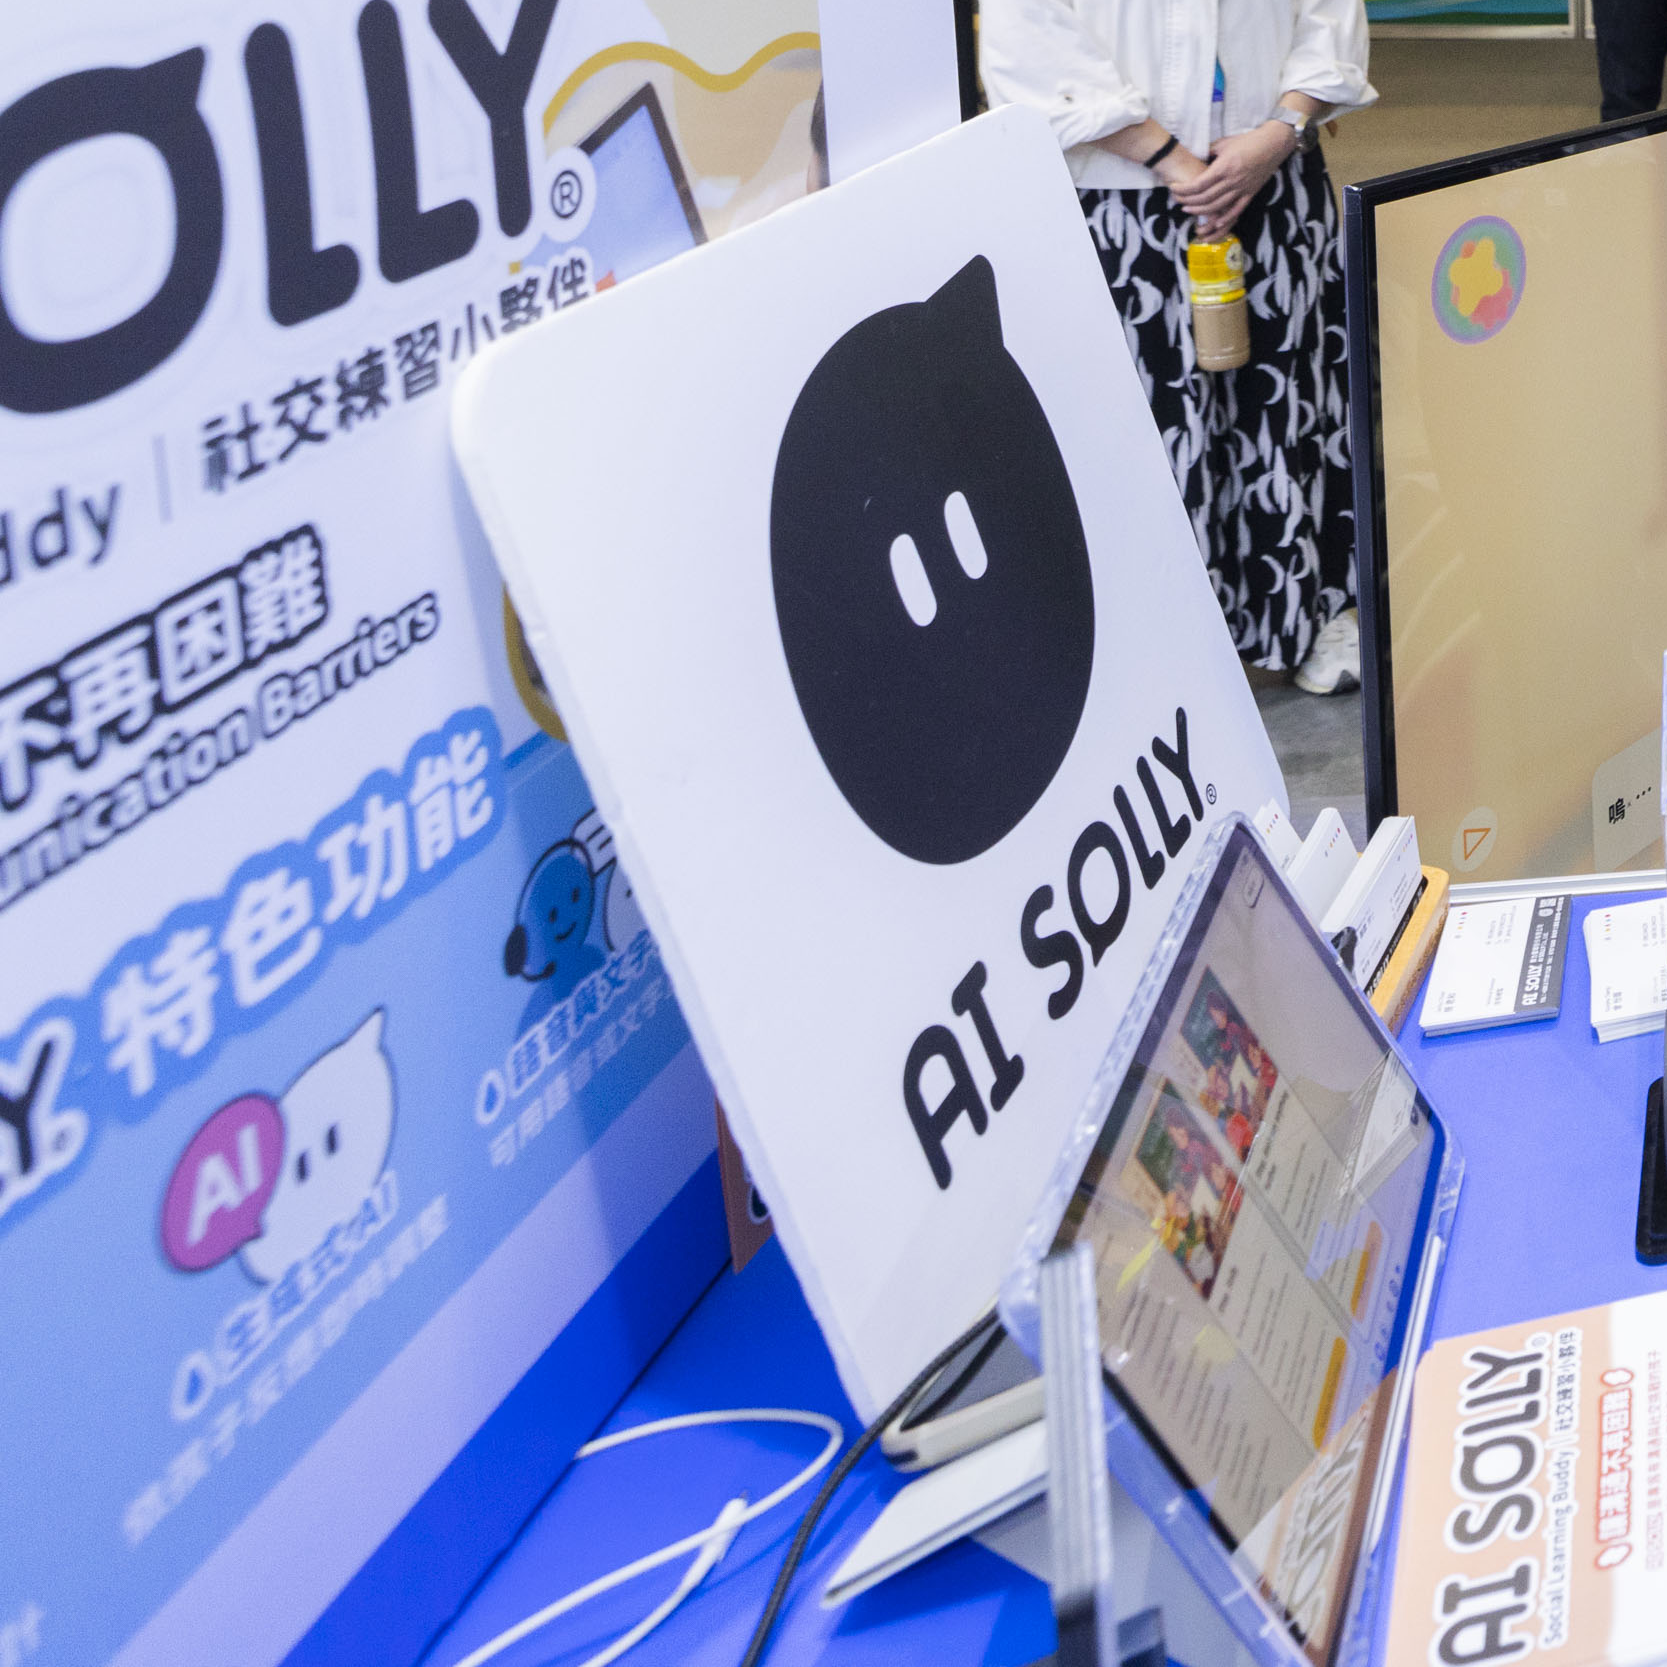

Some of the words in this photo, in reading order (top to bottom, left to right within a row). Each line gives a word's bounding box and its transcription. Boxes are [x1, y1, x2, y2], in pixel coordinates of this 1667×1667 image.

[199, 253, 591, 496] 社交練習小夥伴
[257, 588, 441, 741] Barriers
[100, 727, 495, 1099] 特色功能
[902, 960, 1026, 1191] AI
[184, 1124, 263, 1247] AI
[1551, 1450, 1575, 1503] Buddy
[1551, 1503, 1574, 1583] Learning
[1437, 1562, 1532, 1667] AI
[1544, 1590, 1565, 1647] Social
